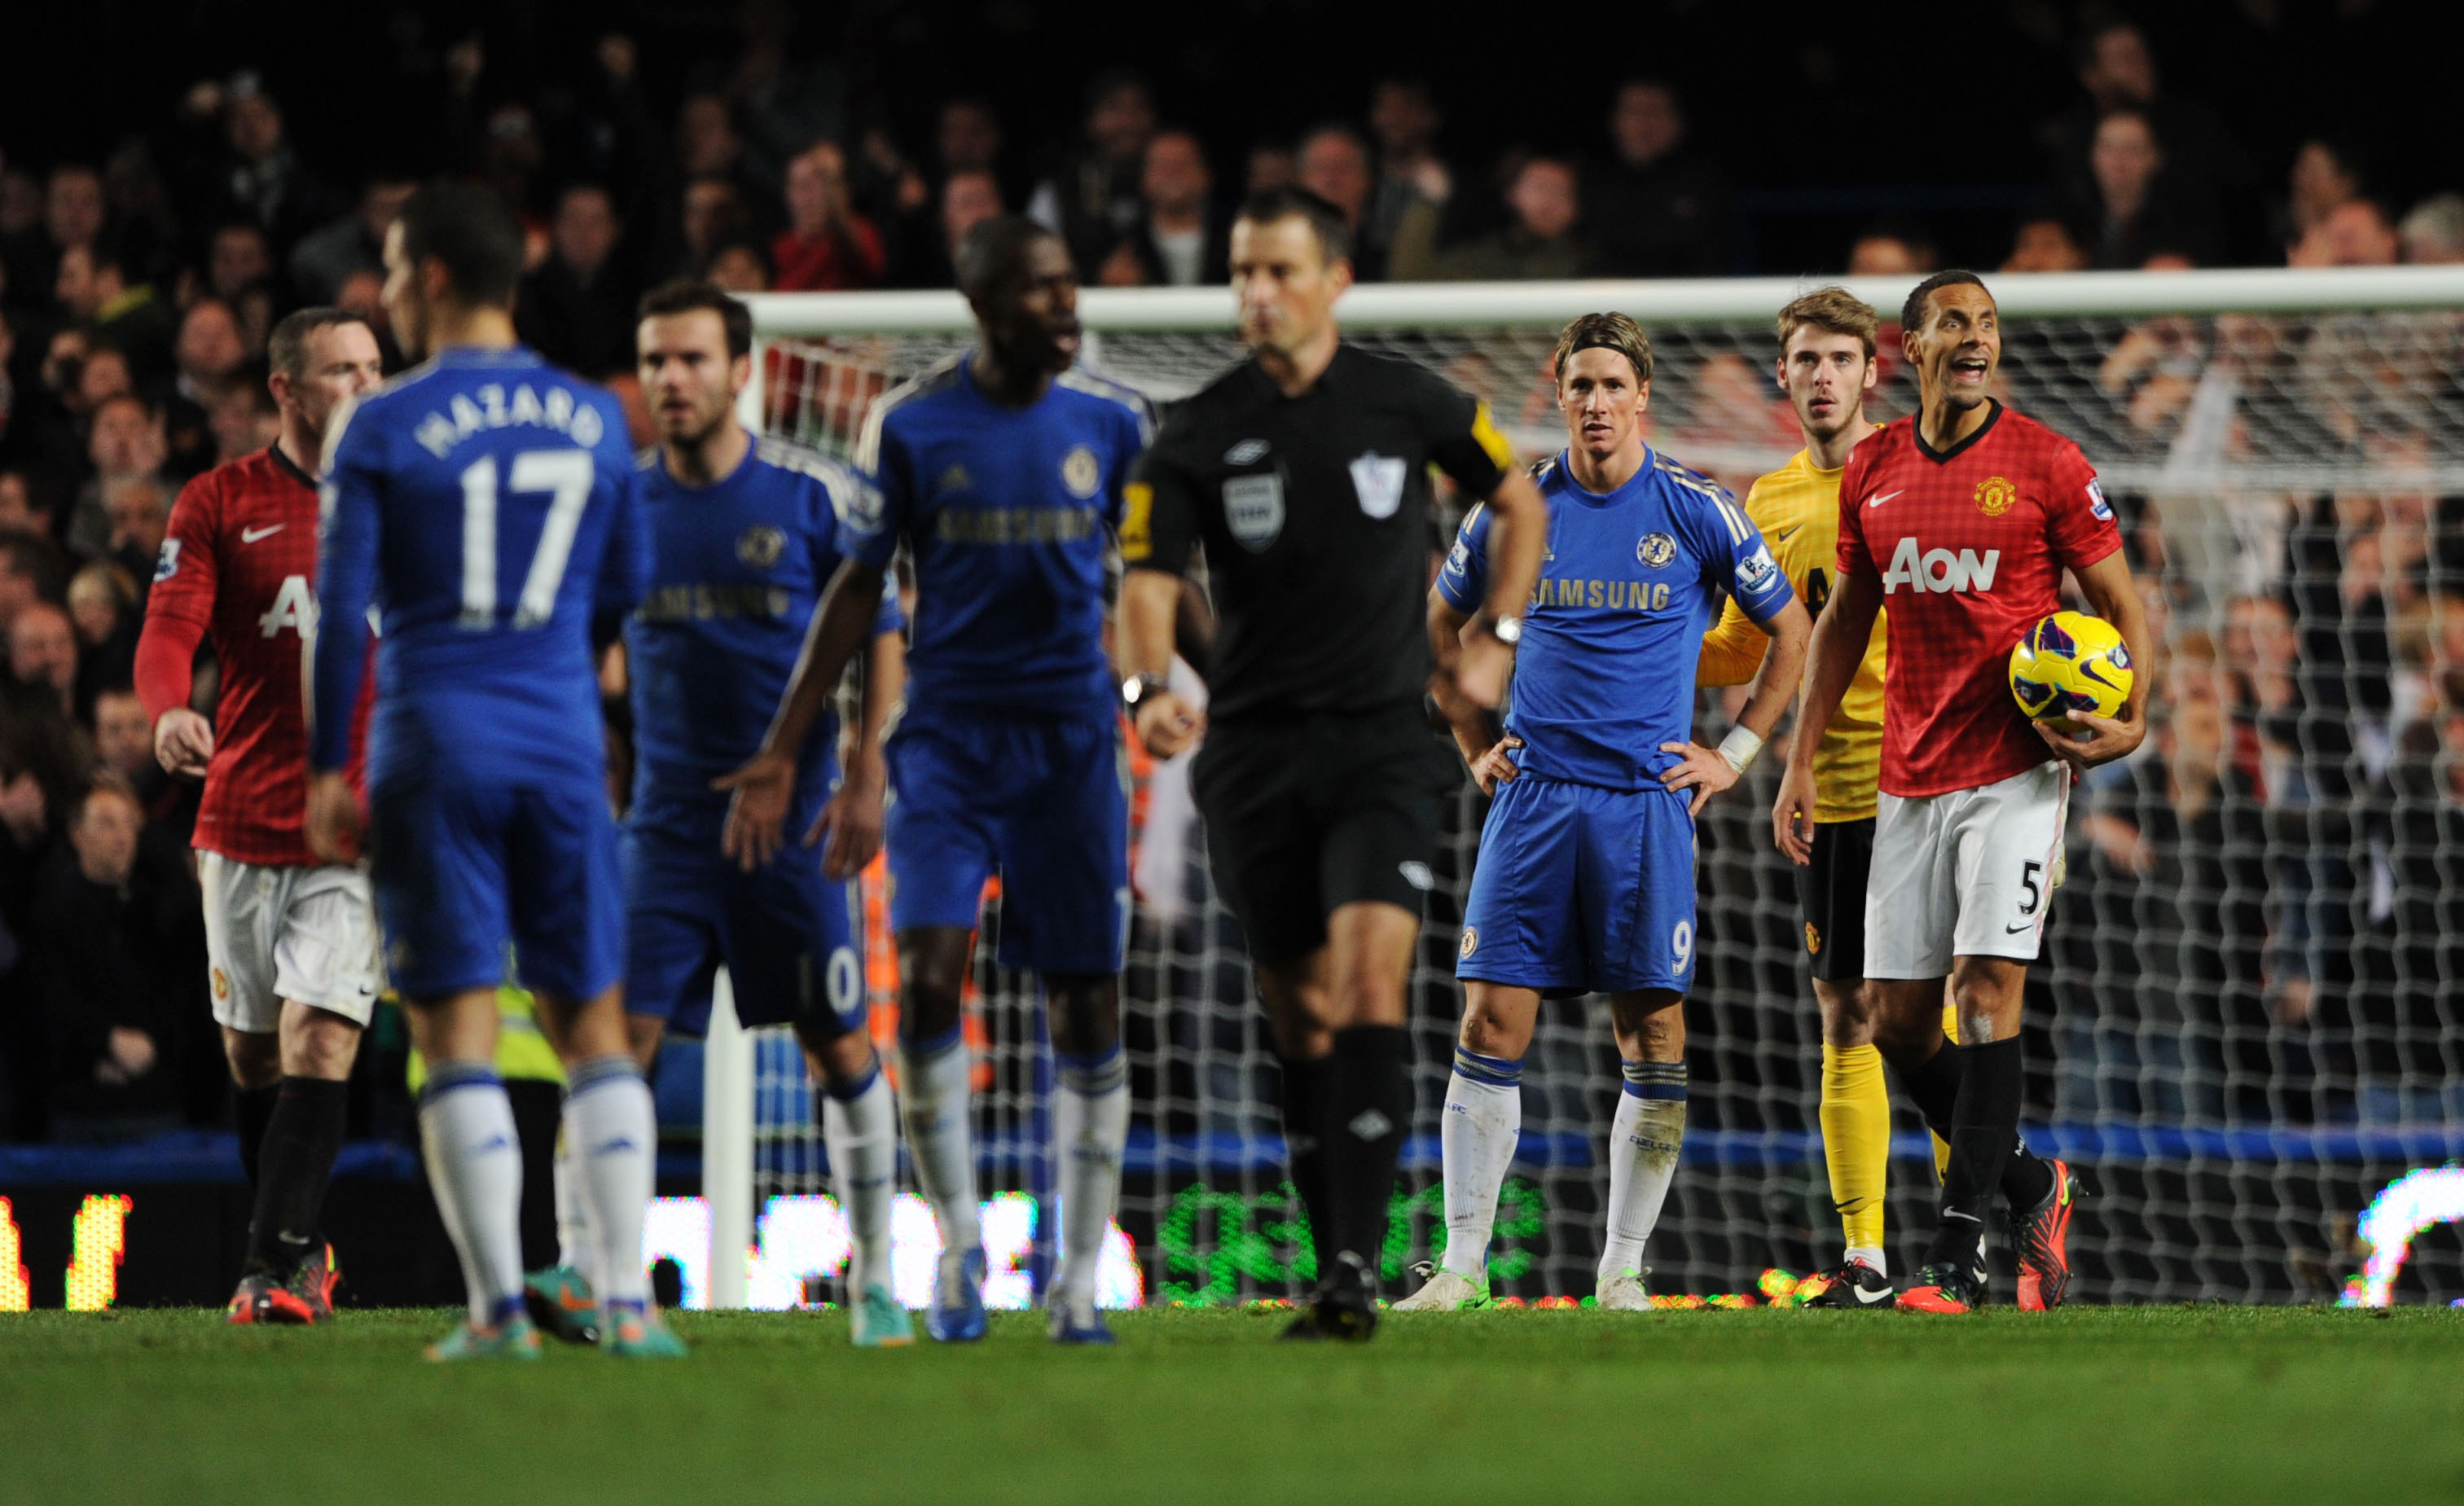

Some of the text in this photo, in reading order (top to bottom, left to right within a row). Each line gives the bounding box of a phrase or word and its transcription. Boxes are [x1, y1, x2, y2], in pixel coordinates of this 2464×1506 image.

[459, 449, 595, 630] 17
[2016, 859, 2042, 917] 5
[1672, 920, 1692, 976] 9
